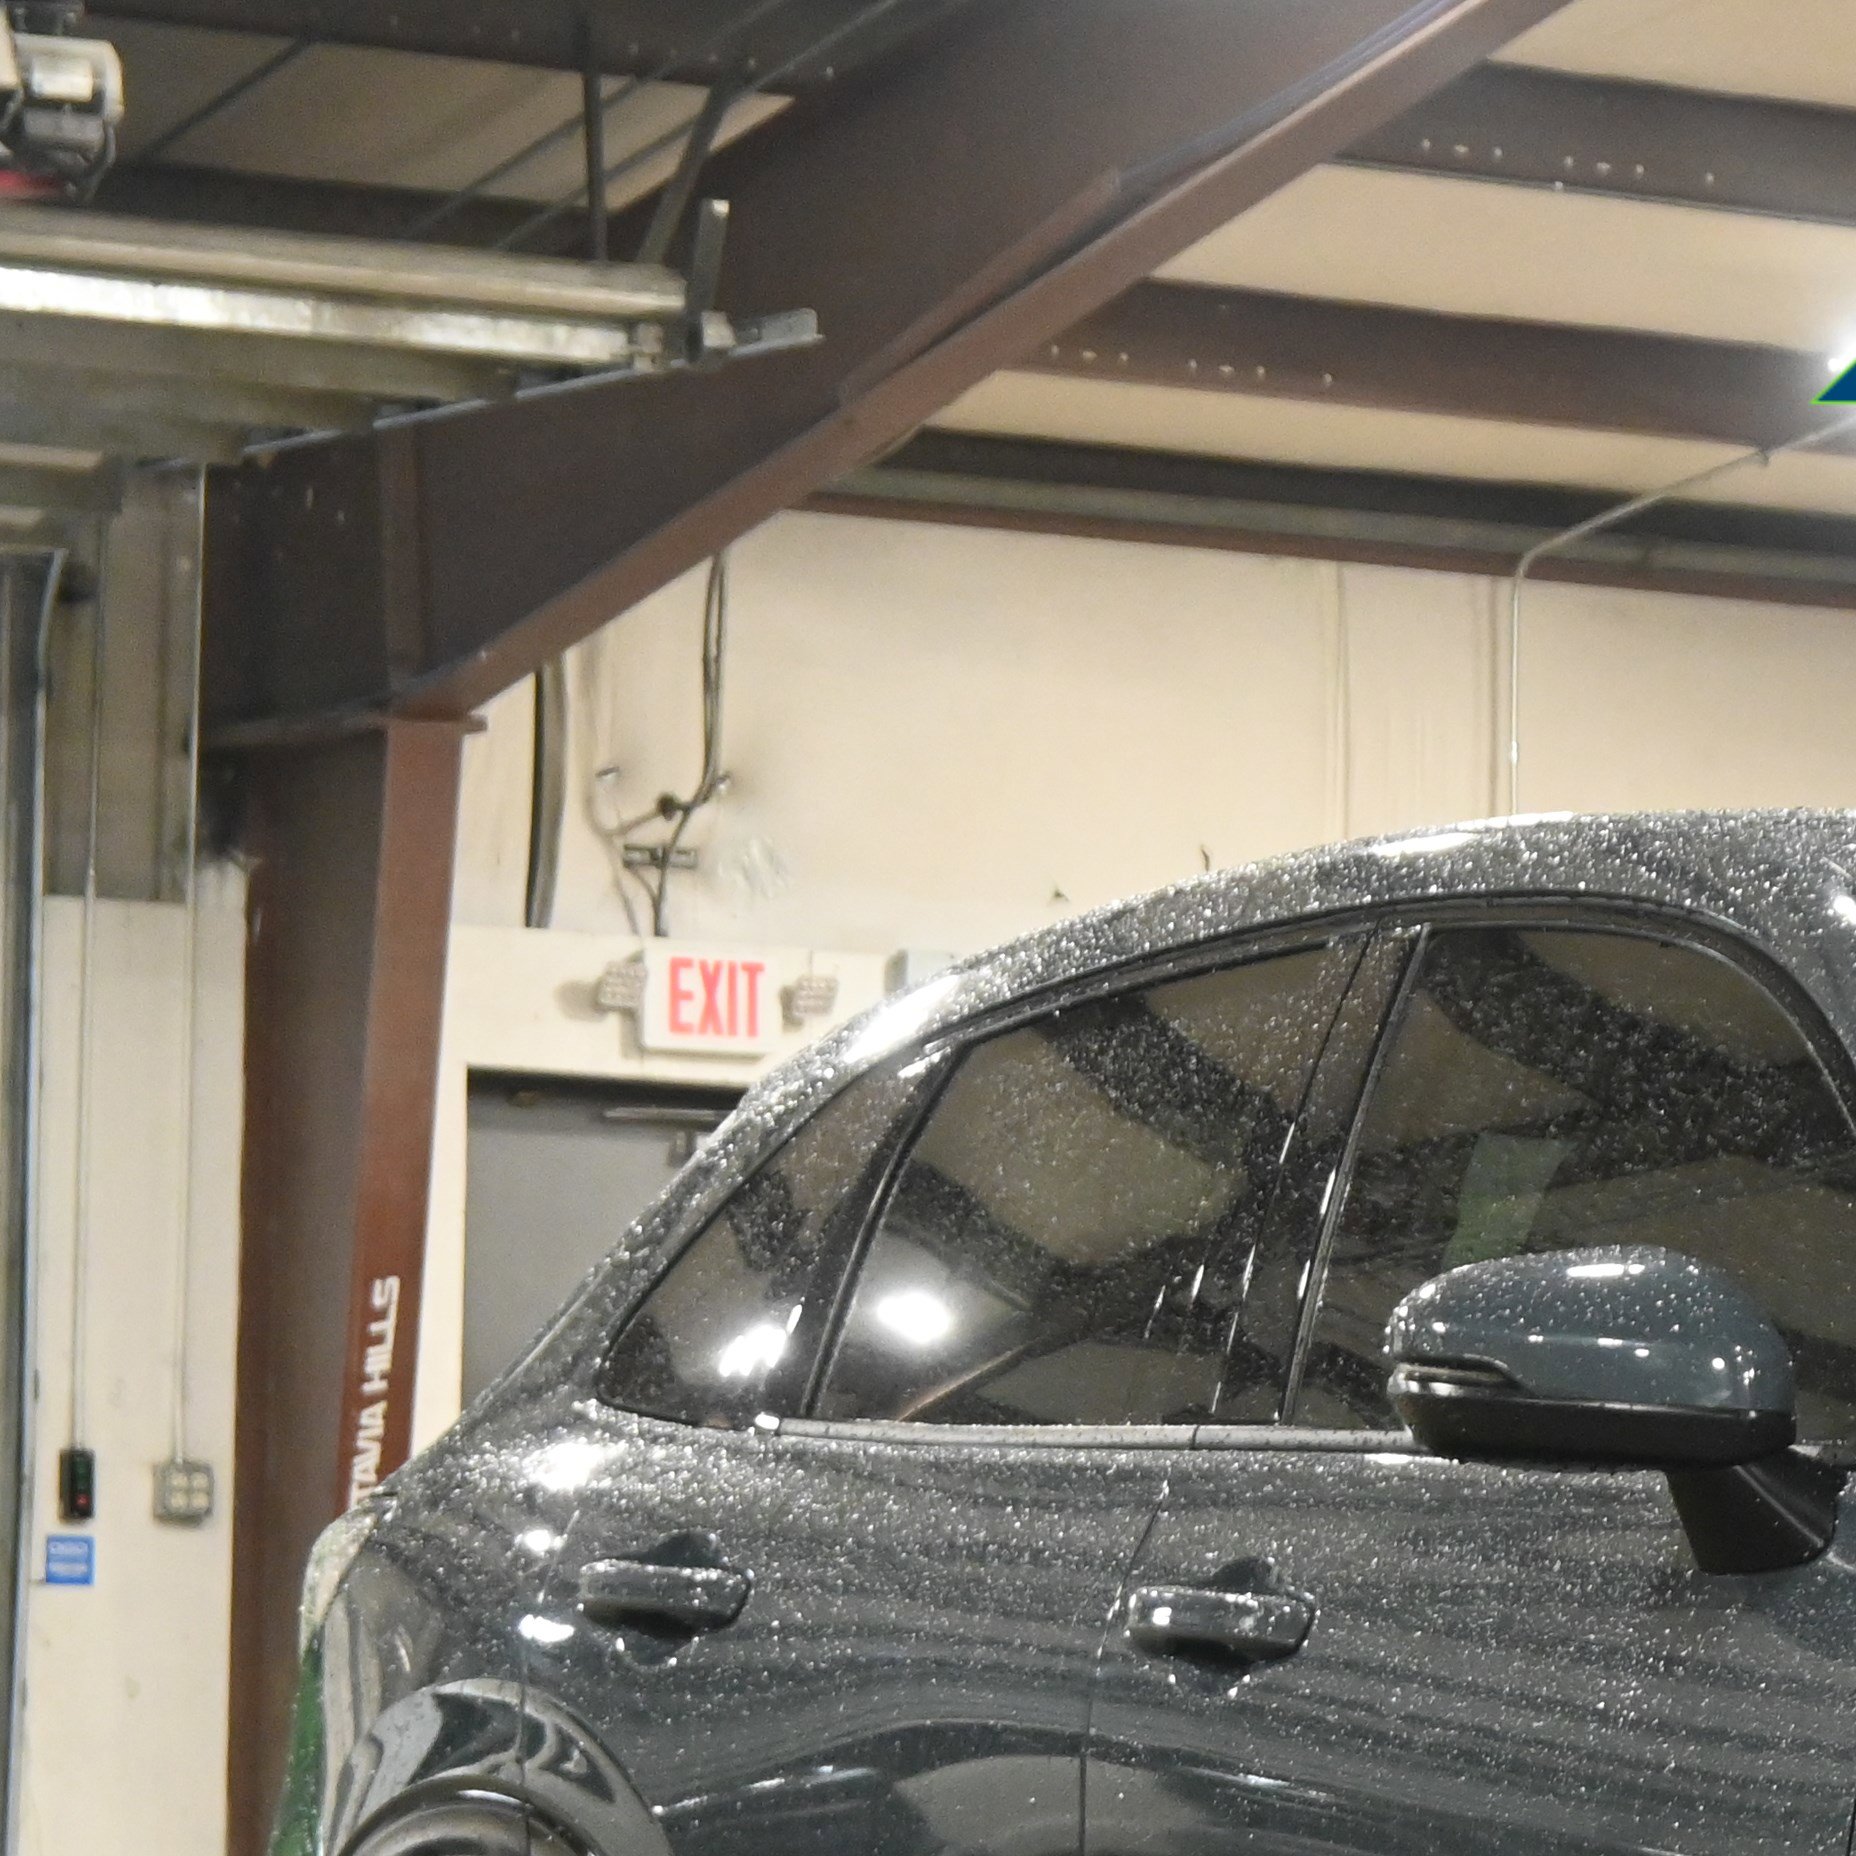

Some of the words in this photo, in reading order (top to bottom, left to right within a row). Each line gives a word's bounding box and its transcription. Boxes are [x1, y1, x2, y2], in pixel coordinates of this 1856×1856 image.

[668, 956, 766, 1038] EXIT
[360, 1274, 400, 1394] HILLS
[348, 1400, 388, 1510] TAVIA
